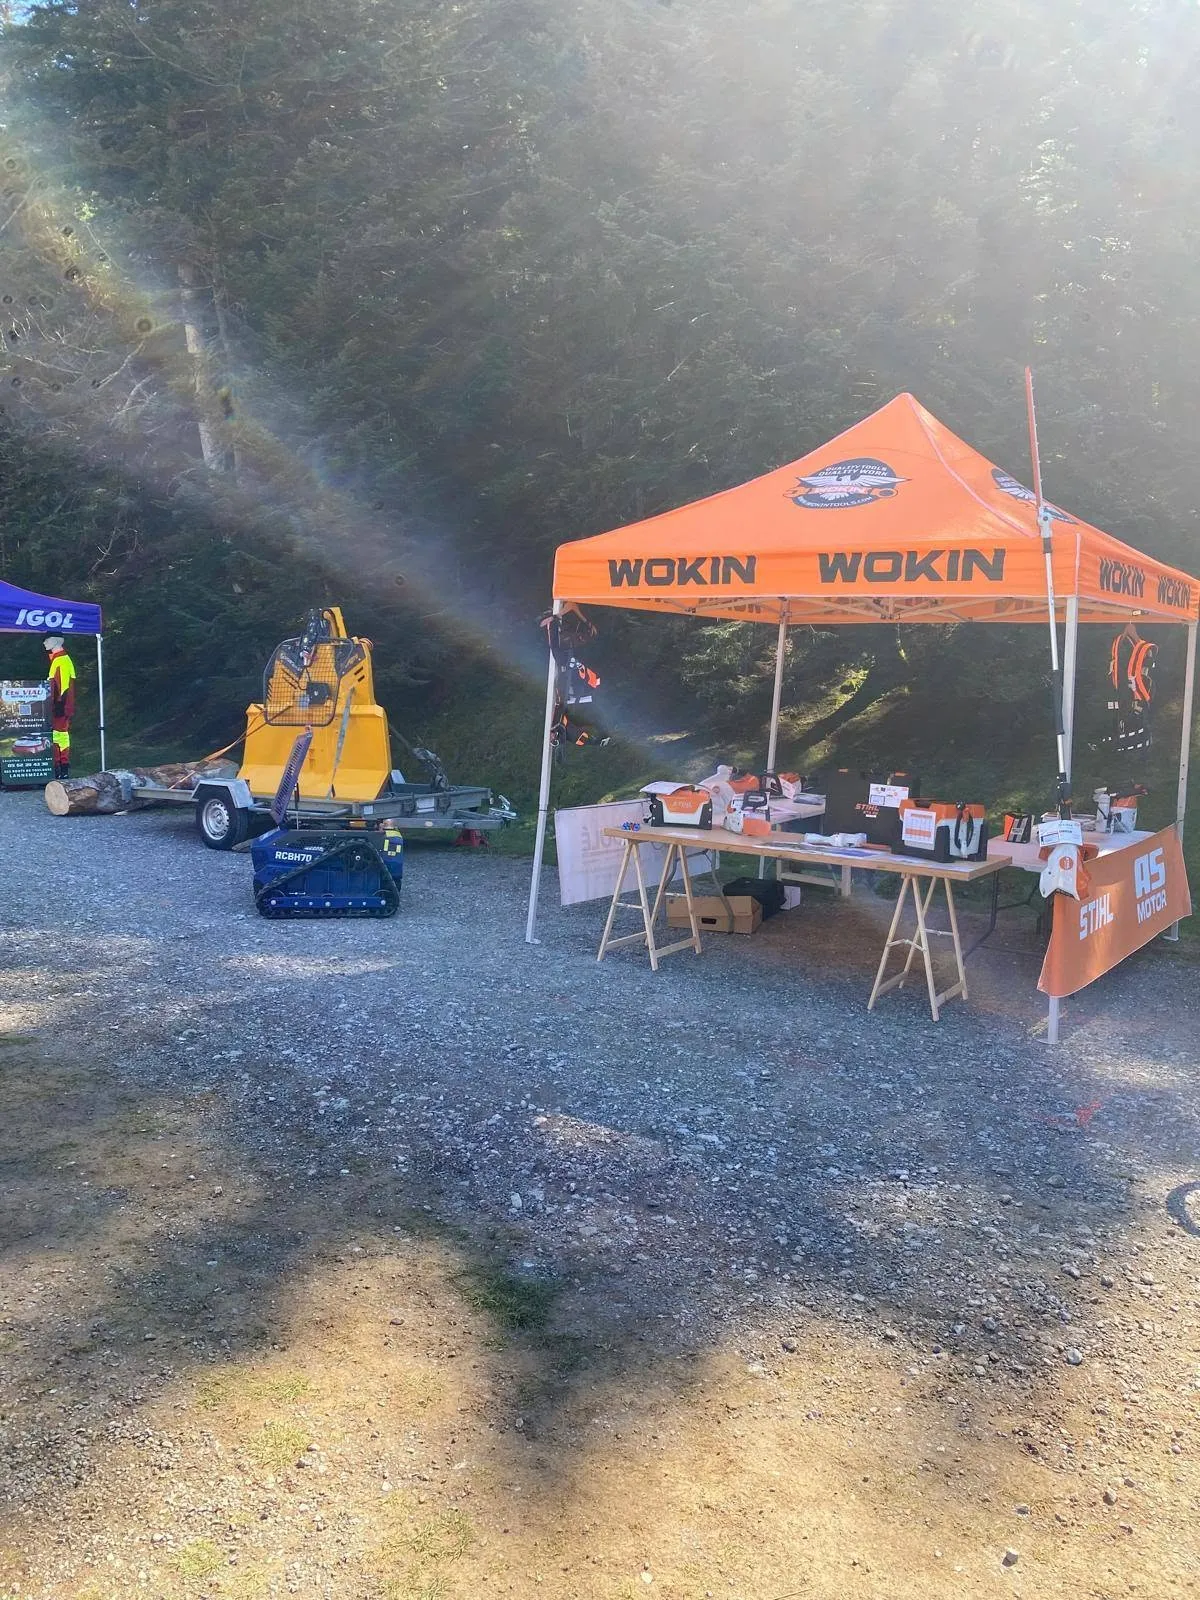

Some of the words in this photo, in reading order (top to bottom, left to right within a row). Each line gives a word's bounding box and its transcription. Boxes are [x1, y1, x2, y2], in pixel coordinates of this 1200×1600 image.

[818, 468, 860, 476] QUALITY
[860, 468, 889, 477] WORK
[825, 464, 861, 472] QUALITY
[608, 555, 757, 588] WOKIN
[817, 548, 1006, 583] WOKIN
[1098, 556, 1146, 599] WOKIN
[1157, 574, 1192, 611] WOKIN
[15, 608, 75, 628] IGOL
[855, 803, 880, 811] STIHL
[275, 851, 312, 862] RCBH70
[1134, 847, 1166, 899] AS
[1079, 892, 1115, 941] STIHL
[1136, 888, 1168, 924] MOTOR
